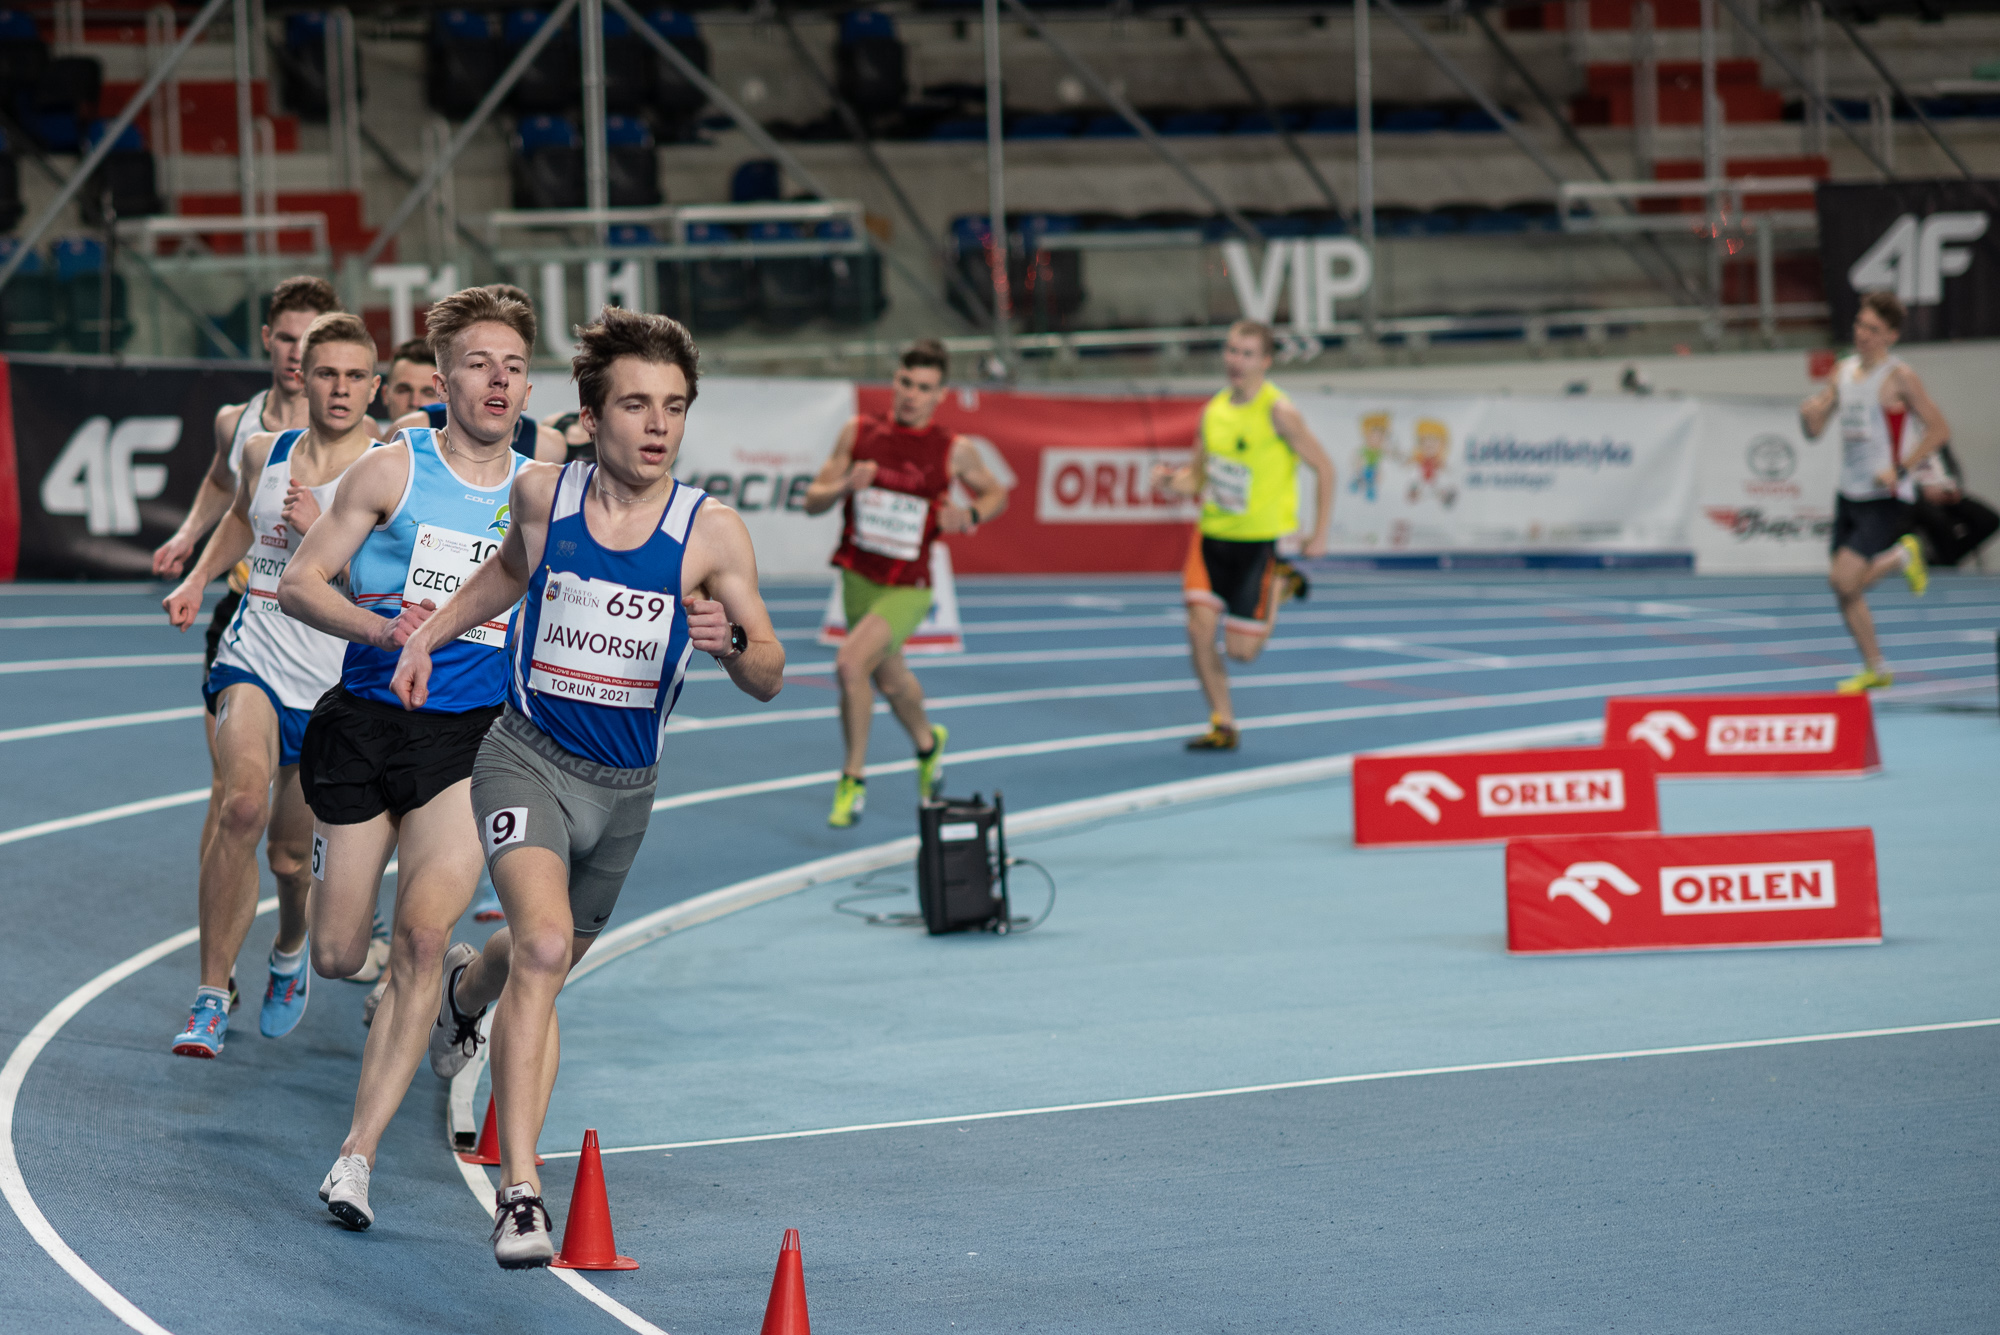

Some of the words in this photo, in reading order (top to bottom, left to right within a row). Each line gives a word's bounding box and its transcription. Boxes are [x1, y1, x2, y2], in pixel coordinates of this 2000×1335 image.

[1848, 212, 1989, 306] 4F
[1222, 235, 1373, 333] VIP
[39, 414, 183, 535] 4F
[1054, 464, 1200, 507] ORL
[464, 494, 495, 505] COLO
[262, 537, 287, 548] ORLEN
[562, 591, 600, 609] TORUŃ
[565, 586, 593, 597] MIASTO
[606, 592, 665, 622] 659
[465, 628, 486, 640] 2021
[543, 623, 659, 661] JAWORSKI
[548, 665, 570, 676] HALOWE
[570, 671, 612, 683] MISTRZOSTWA
[612, 678, 632, 686] POLSKI
[551, 678, 596, 698] TORUŃ
[599, 688, 630, 702] 2021
[1718, 725, 1824, 744] ORLEN
[536, 738, 593, 778] NIKE
[594, 766, 645, 786] PRO
[1490, 780, 1611, 806] ORLEN
[1672, 871, 1822, 904] ORLEN
